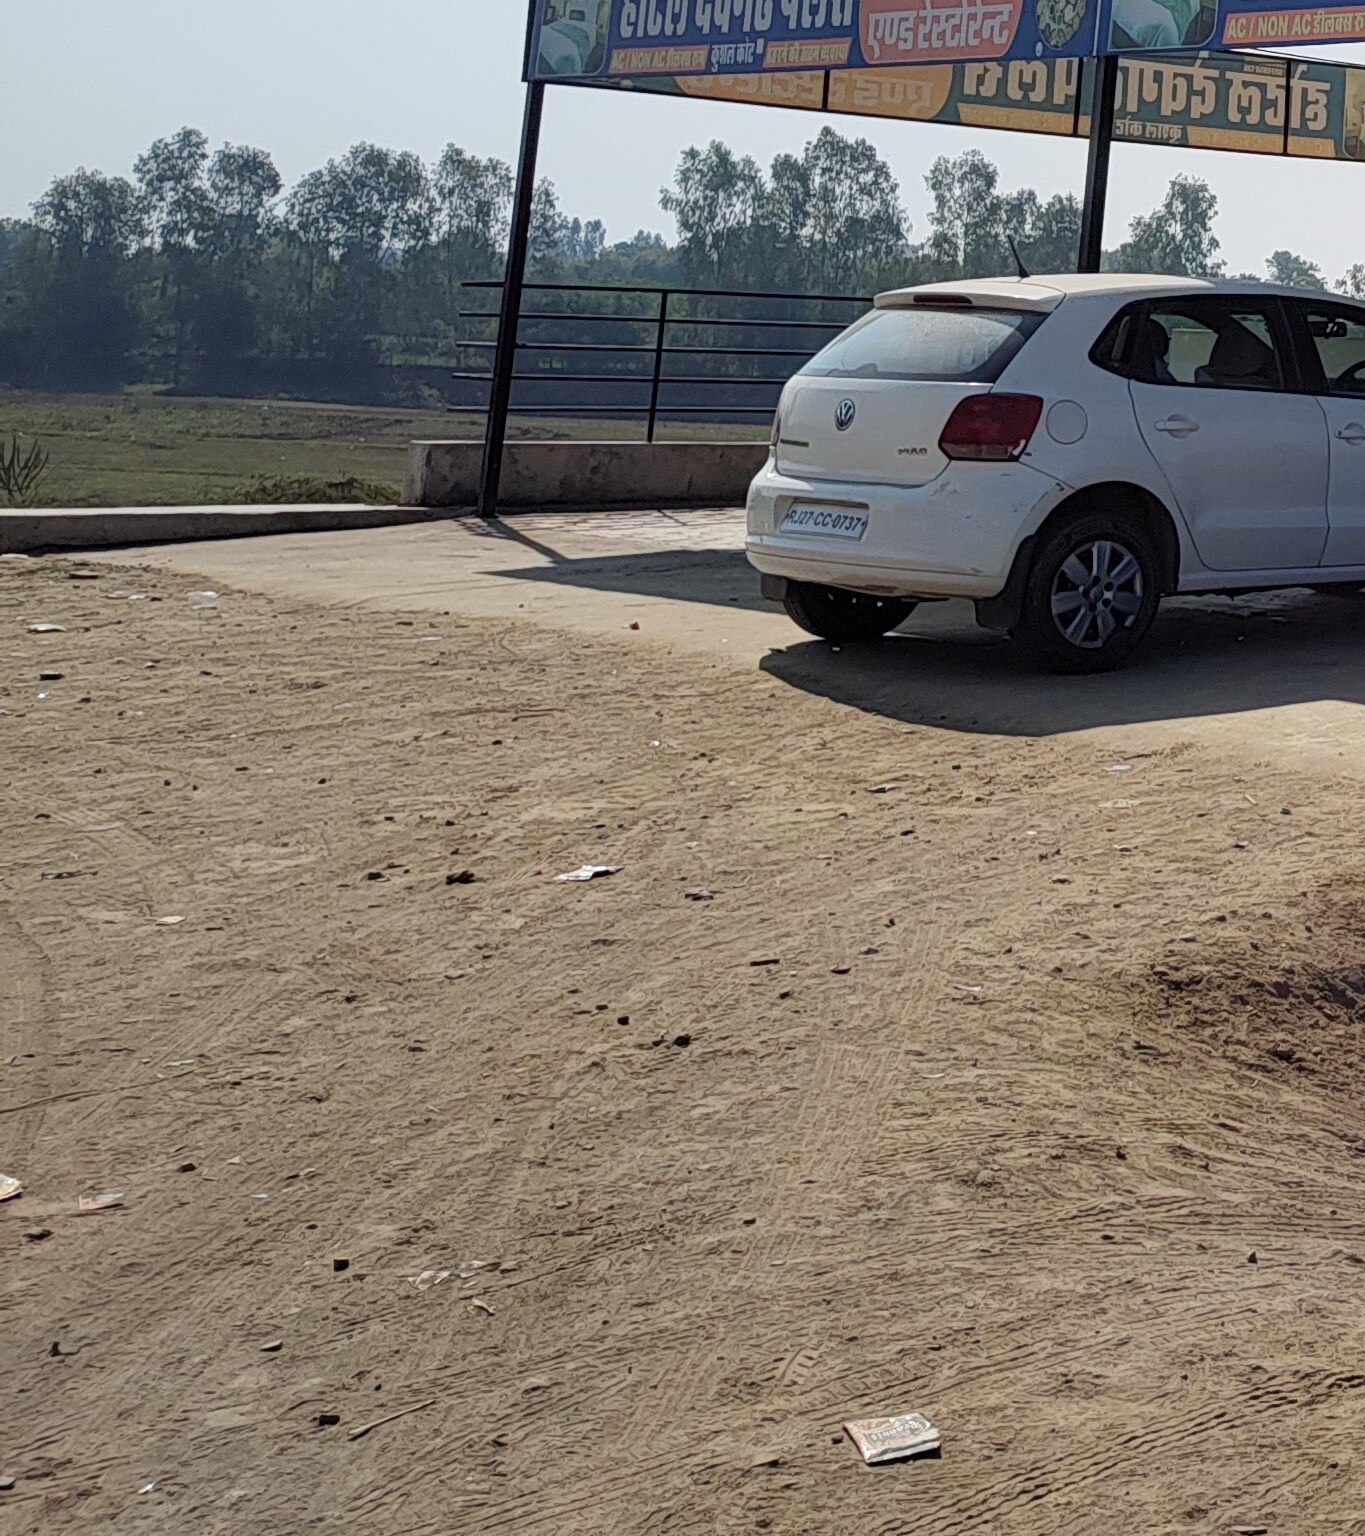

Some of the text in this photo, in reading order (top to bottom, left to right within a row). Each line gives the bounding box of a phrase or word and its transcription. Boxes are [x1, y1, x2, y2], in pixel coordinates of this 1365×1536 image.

[868, 10, 918, 59] एण्ड
[1227, 17, 1246, 39] AC
[1258, 15, 1288, 37] NON
[1292, 15, 1311, 35] AC
[631, 51, 652, 69] NON
[652, 50, 666, 68] AC
[711, 36, 755, 72] कुशल कोट
